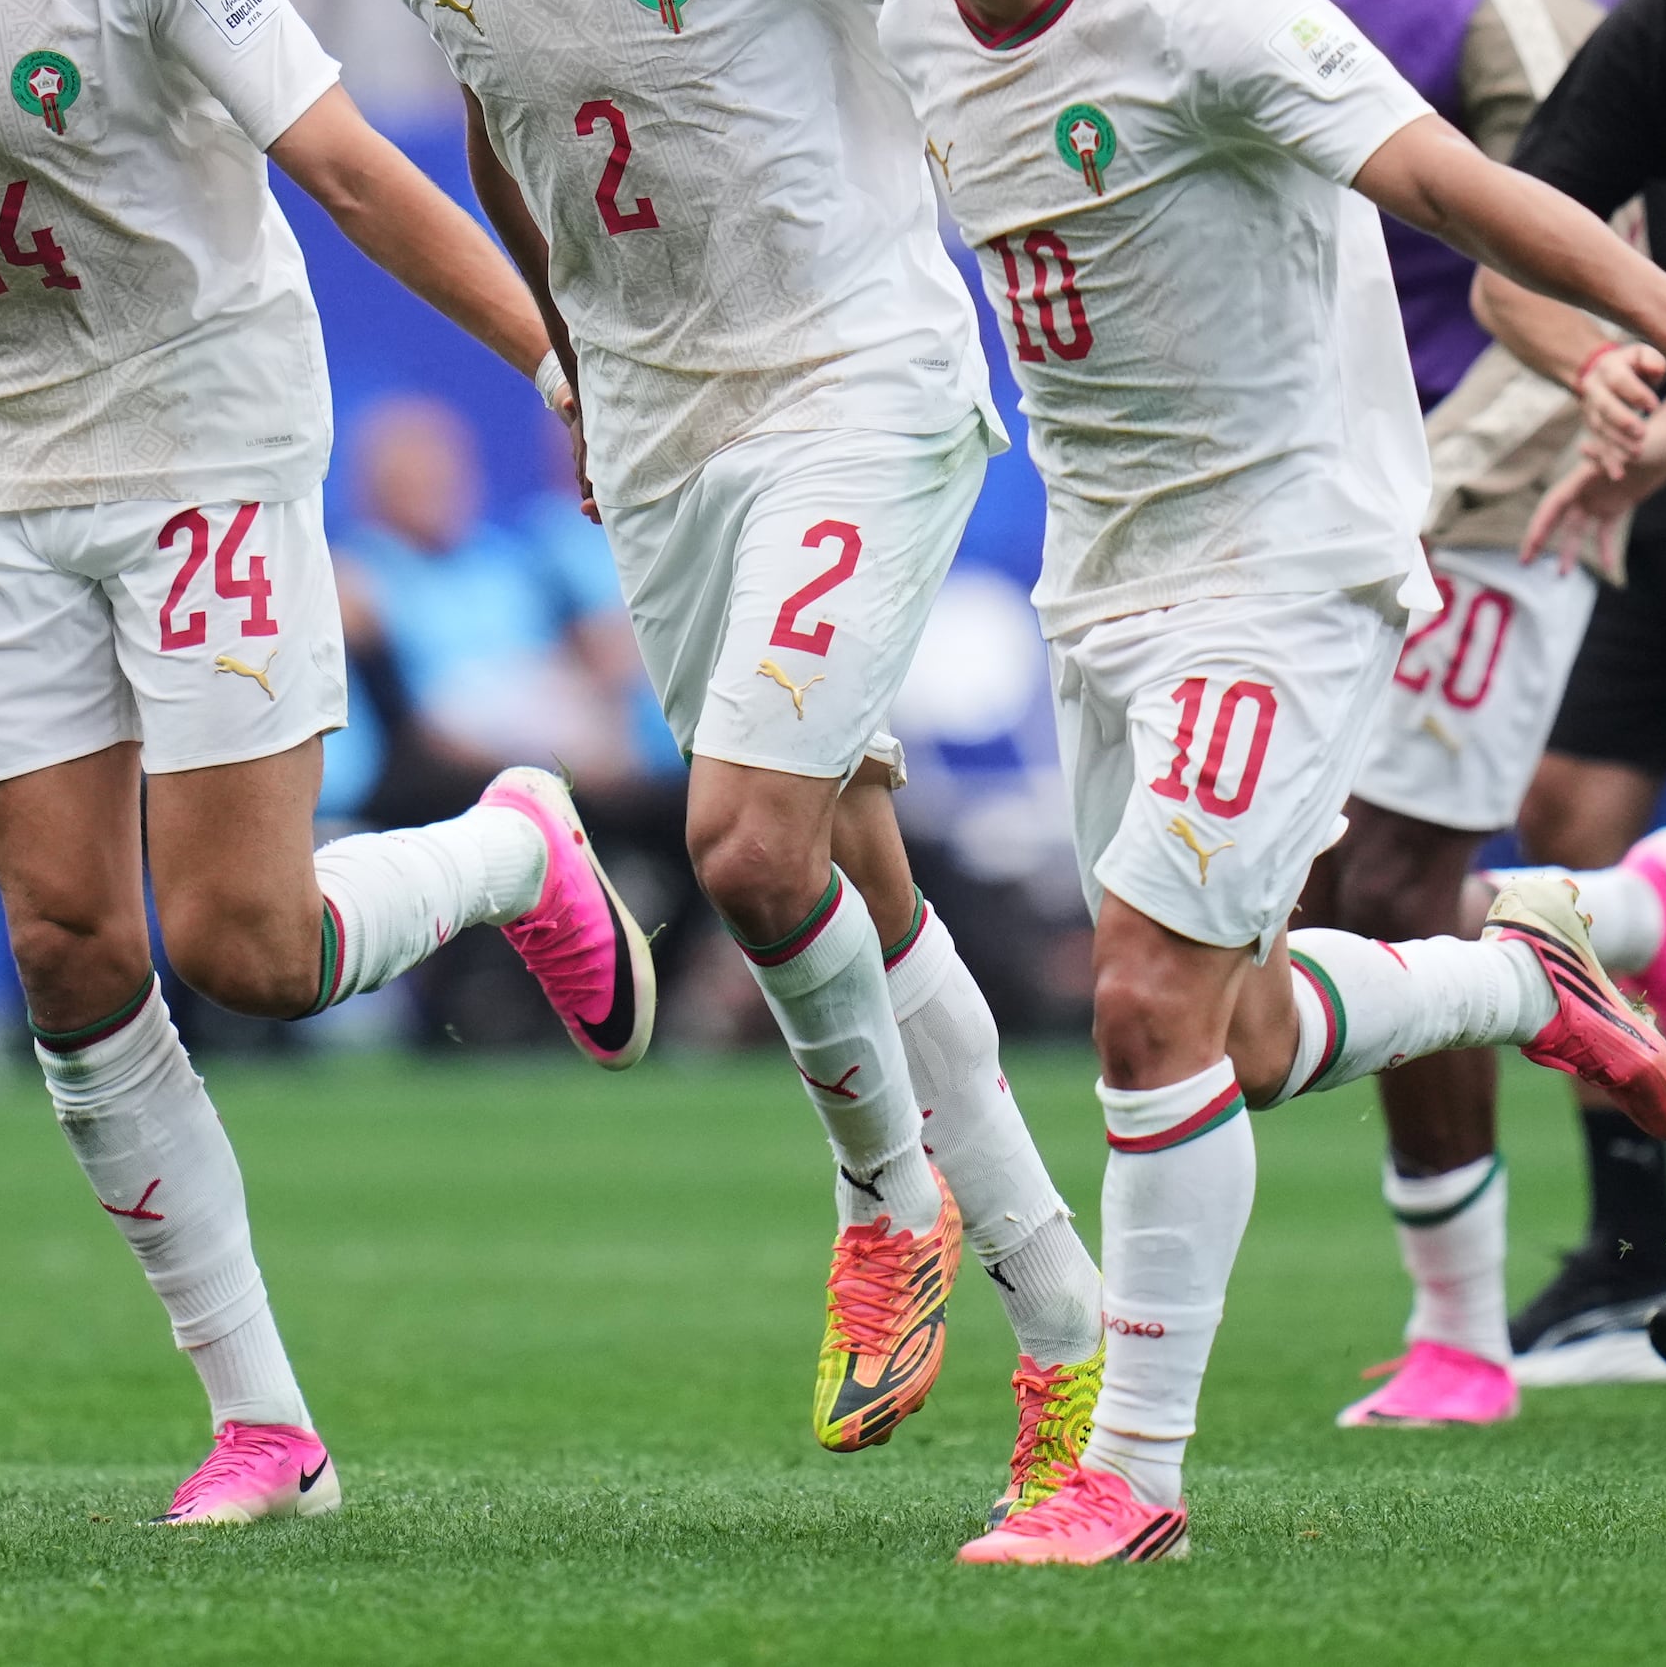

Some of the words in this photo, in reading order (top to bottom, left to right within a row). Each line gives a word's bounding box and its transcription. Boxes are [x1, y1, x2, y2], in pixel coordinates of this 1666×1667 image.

[247, 11, 263, 26] FIFA
[573, 99, 660, 235] 2
[987, 229, 1094, 364] 10
[158, 500, 279, 652] 24
[769, 519, 863, 657] 2
[1392, 570, 1514, 712] 20
[1149, 677, 1278, 820] 10
